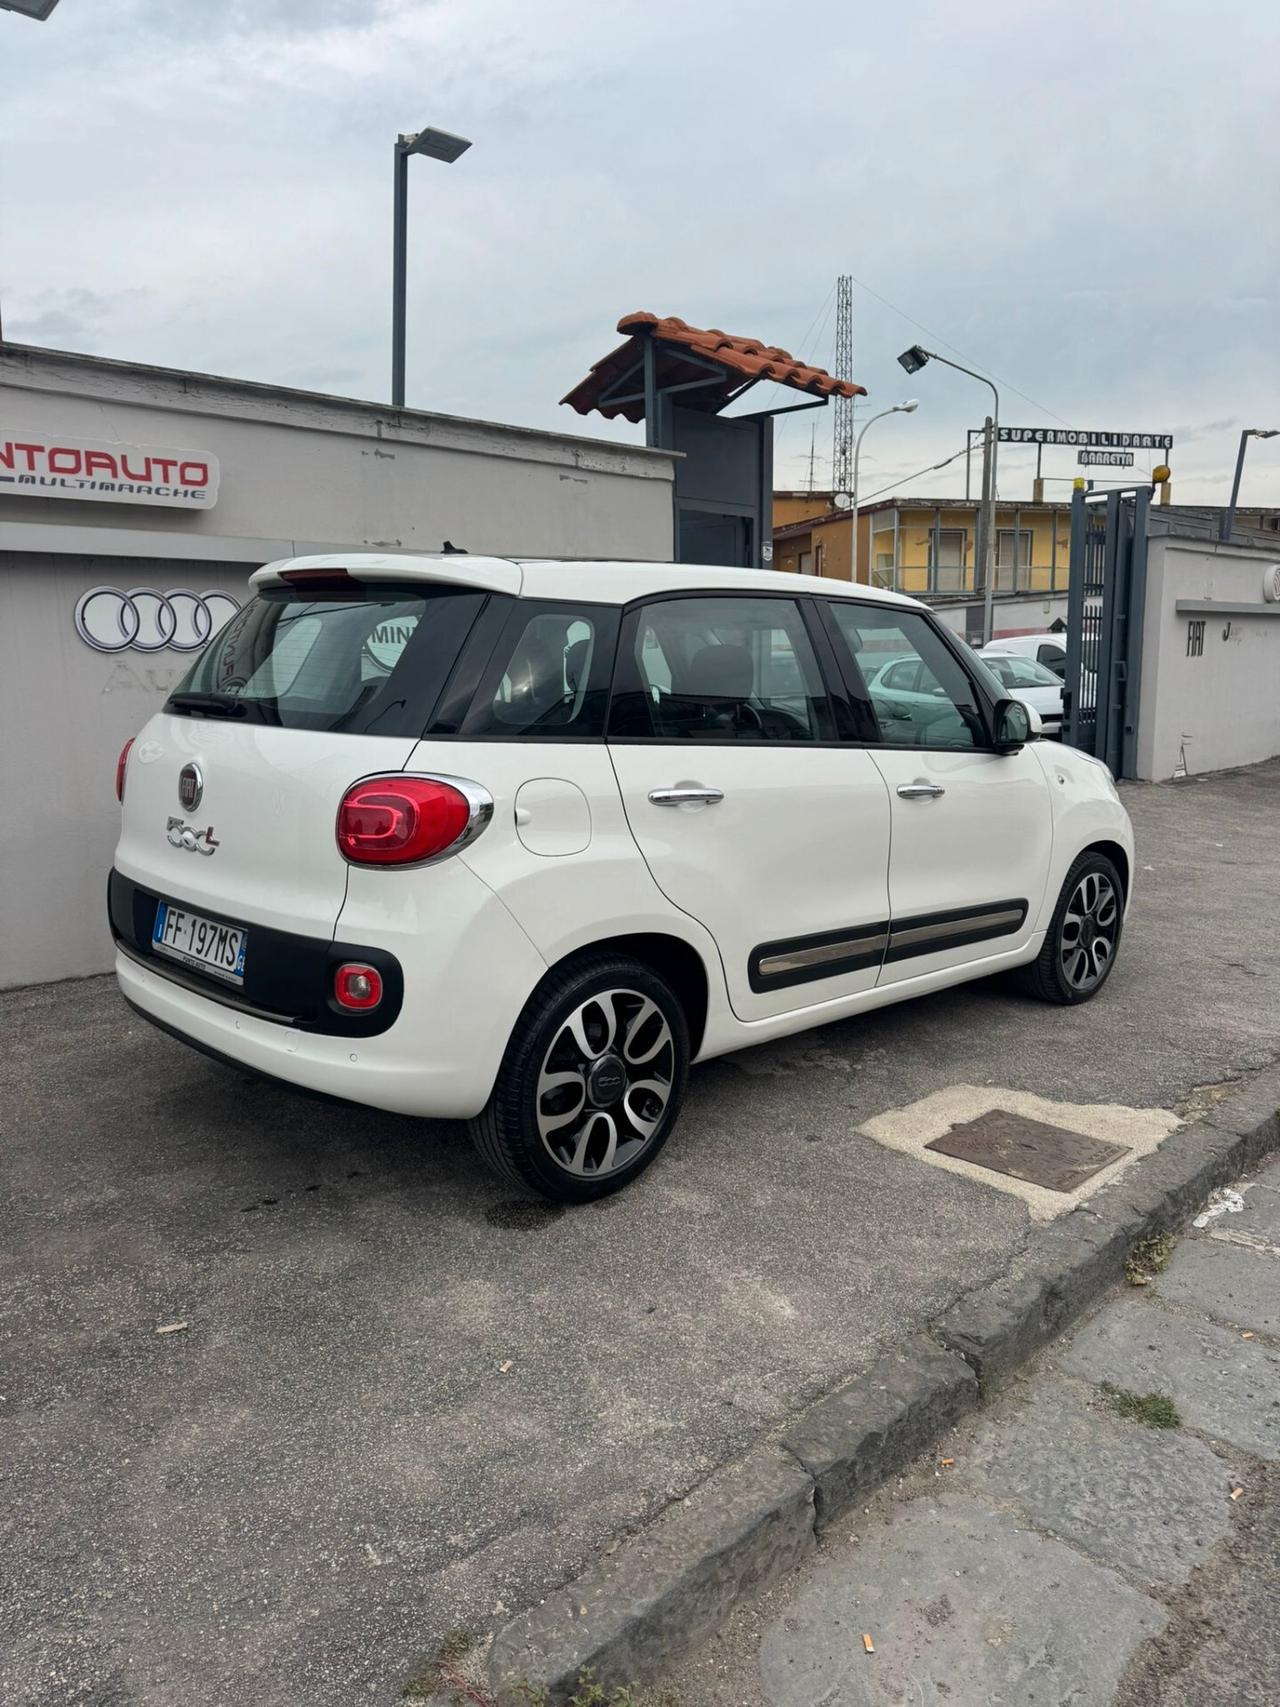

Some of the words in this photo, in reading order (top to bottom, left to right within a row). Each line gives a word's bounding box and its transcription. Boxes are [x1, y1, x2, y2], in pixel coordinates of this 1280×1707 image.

[1081, 451, 1133, 465] BARRETTA
[18, 474, 206, 499] MULTIMARCHE
[370, 625, 417, 644] MIN
[1186, 620, 1206, 657] FIAT
